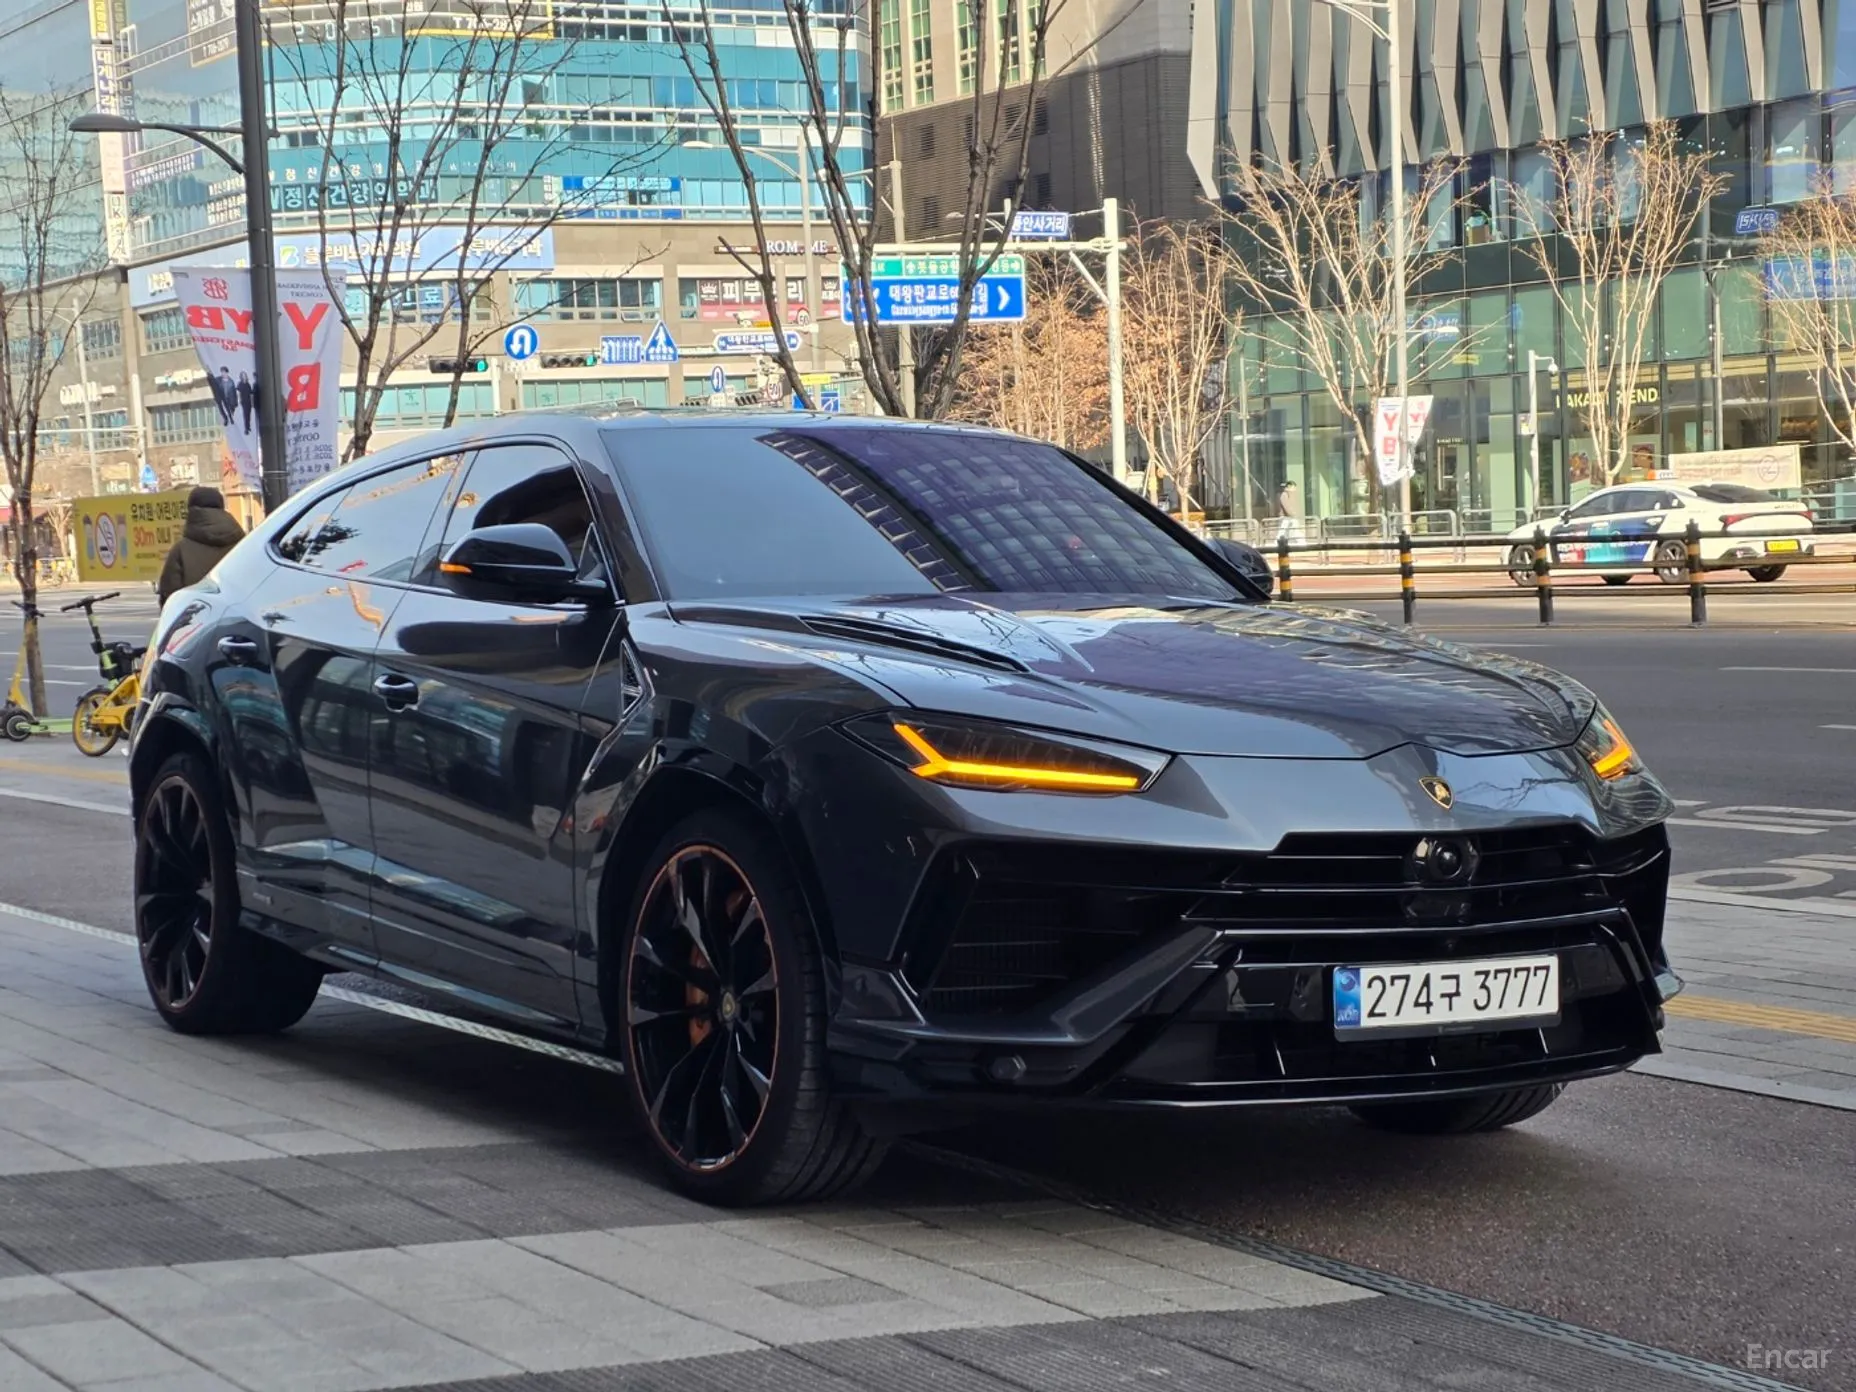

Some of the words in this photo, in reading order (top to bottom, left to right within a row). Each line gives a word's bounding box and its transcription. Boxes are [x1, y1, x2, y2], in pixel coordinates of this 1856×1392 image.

[723, 280, 803, 303] 피부리
[133, 526, 155, 547] 30m
[1366, 973, 1462, 1018] 274구
[1473, 965, 1551, 1012] 3777
